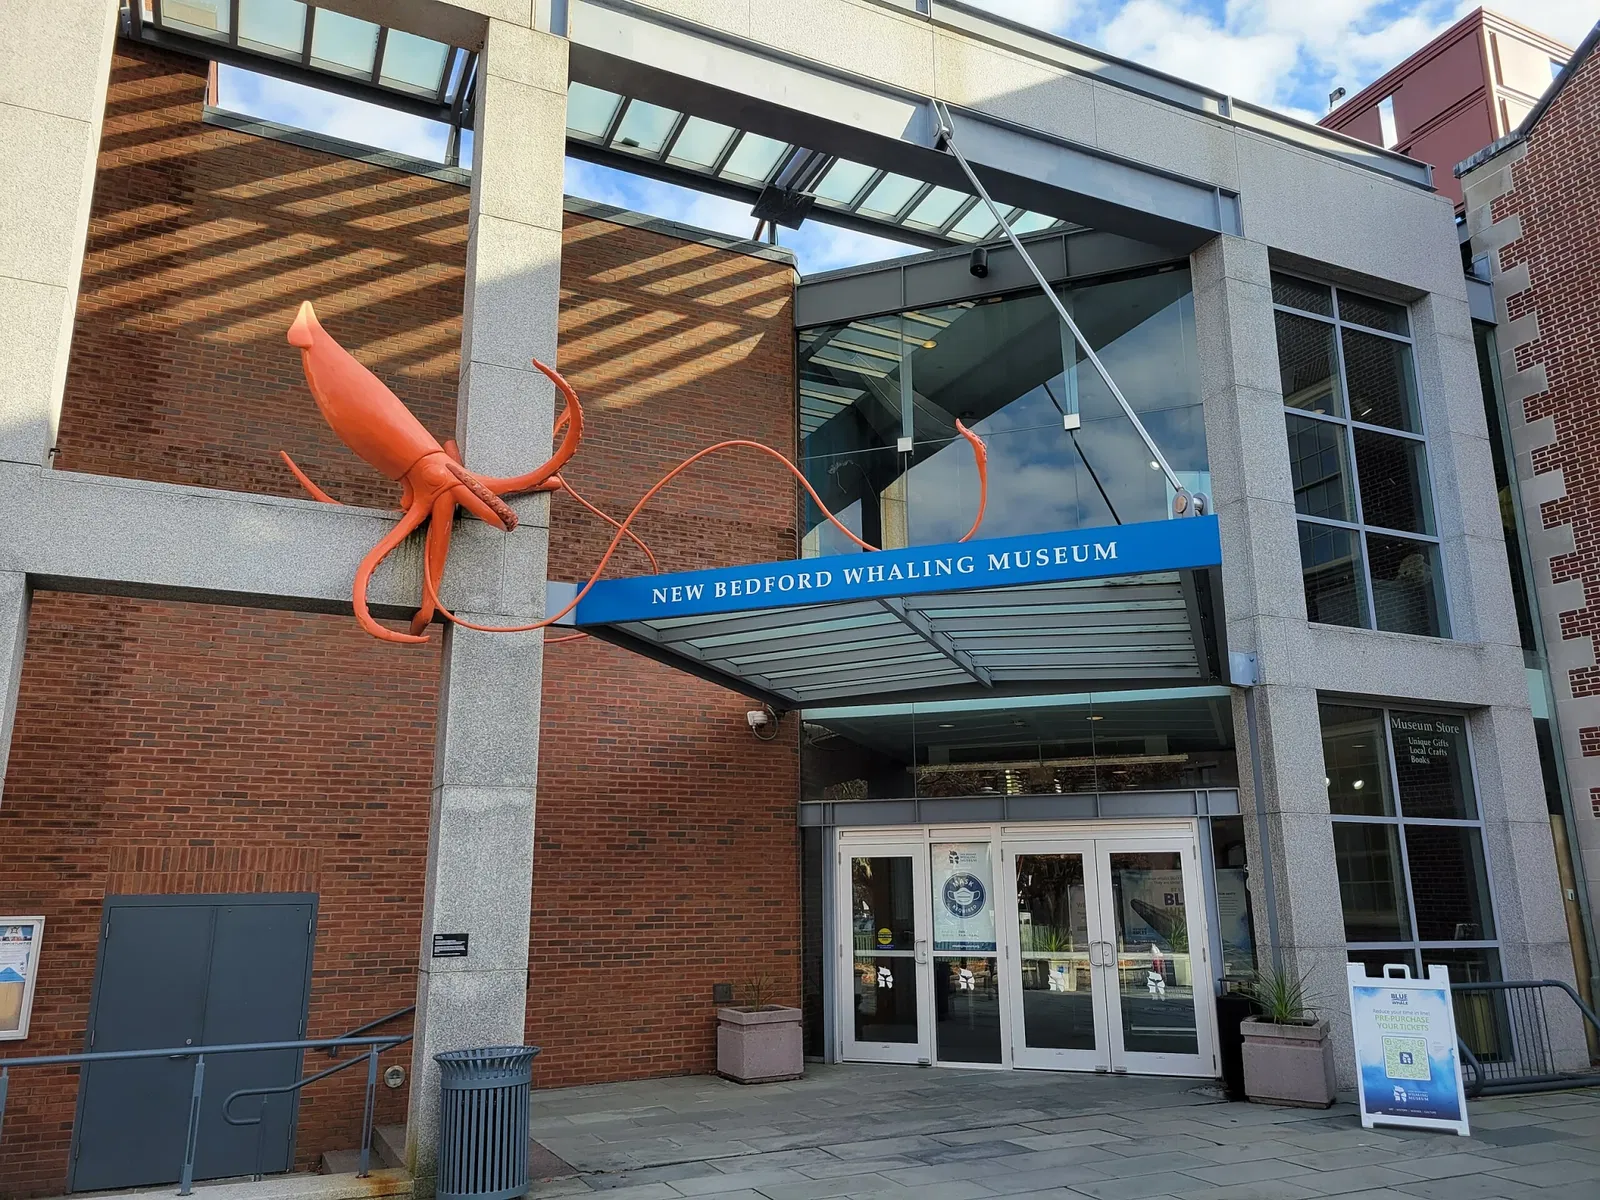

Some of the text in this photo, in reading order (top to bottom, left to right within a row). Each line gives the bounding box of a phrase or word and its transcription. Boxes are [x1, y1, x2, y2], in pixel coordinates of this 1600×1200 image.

[651, 541, 1119, 604] NEW BEDFORD WHALING MUSEUM
[1391, 717, 1460, 734] Museum Store
[1408, 737, 1449, 748] Unique Gifts
[1409, 746, 1448, 756] Local Crafts
[1410, 755, 1430, 764] Books
[952, 878, 974, 888] MASK
[952, 904, 977, 914] REQUIRED
[1374, 1014, 1430, 1024] PRE-PURCHASE
[1377, 1022, 1429, 1032] YOUR TICKETS
